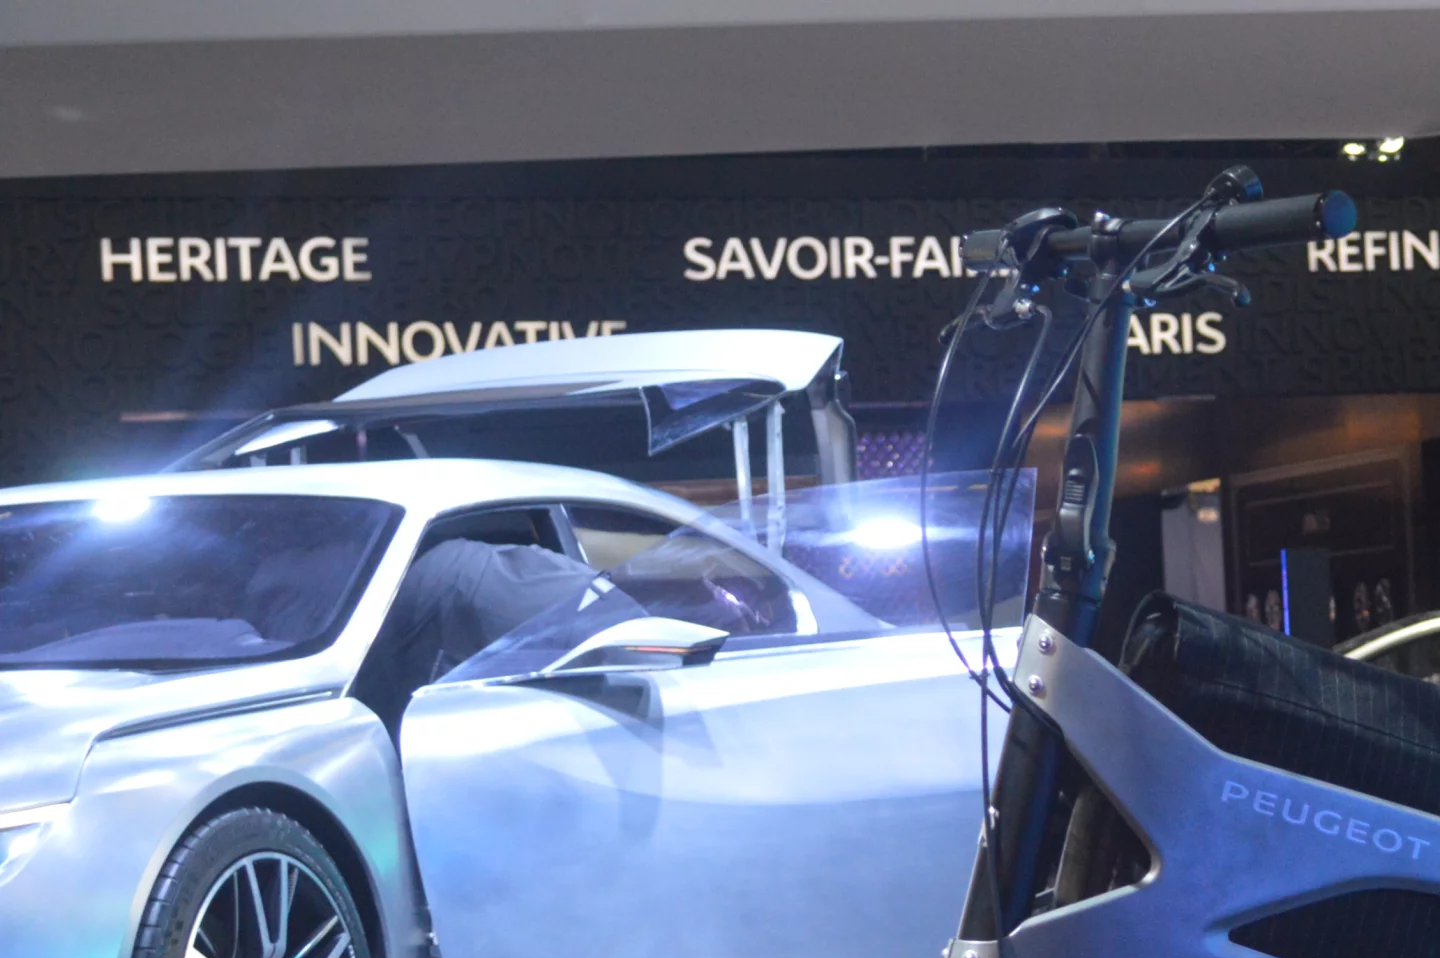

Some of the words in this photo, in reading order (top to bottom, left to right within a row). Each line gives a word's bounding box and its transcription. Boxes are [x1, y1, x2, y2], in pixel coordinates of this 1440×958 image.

[100, 236, 372, 284] HERITAGE
[683, 236, 1010, 281] SAVOIR-FAI
[1125, 312, 1227, 355] ARIS
[1220, 780, 1432, 861] PEUGEOT
